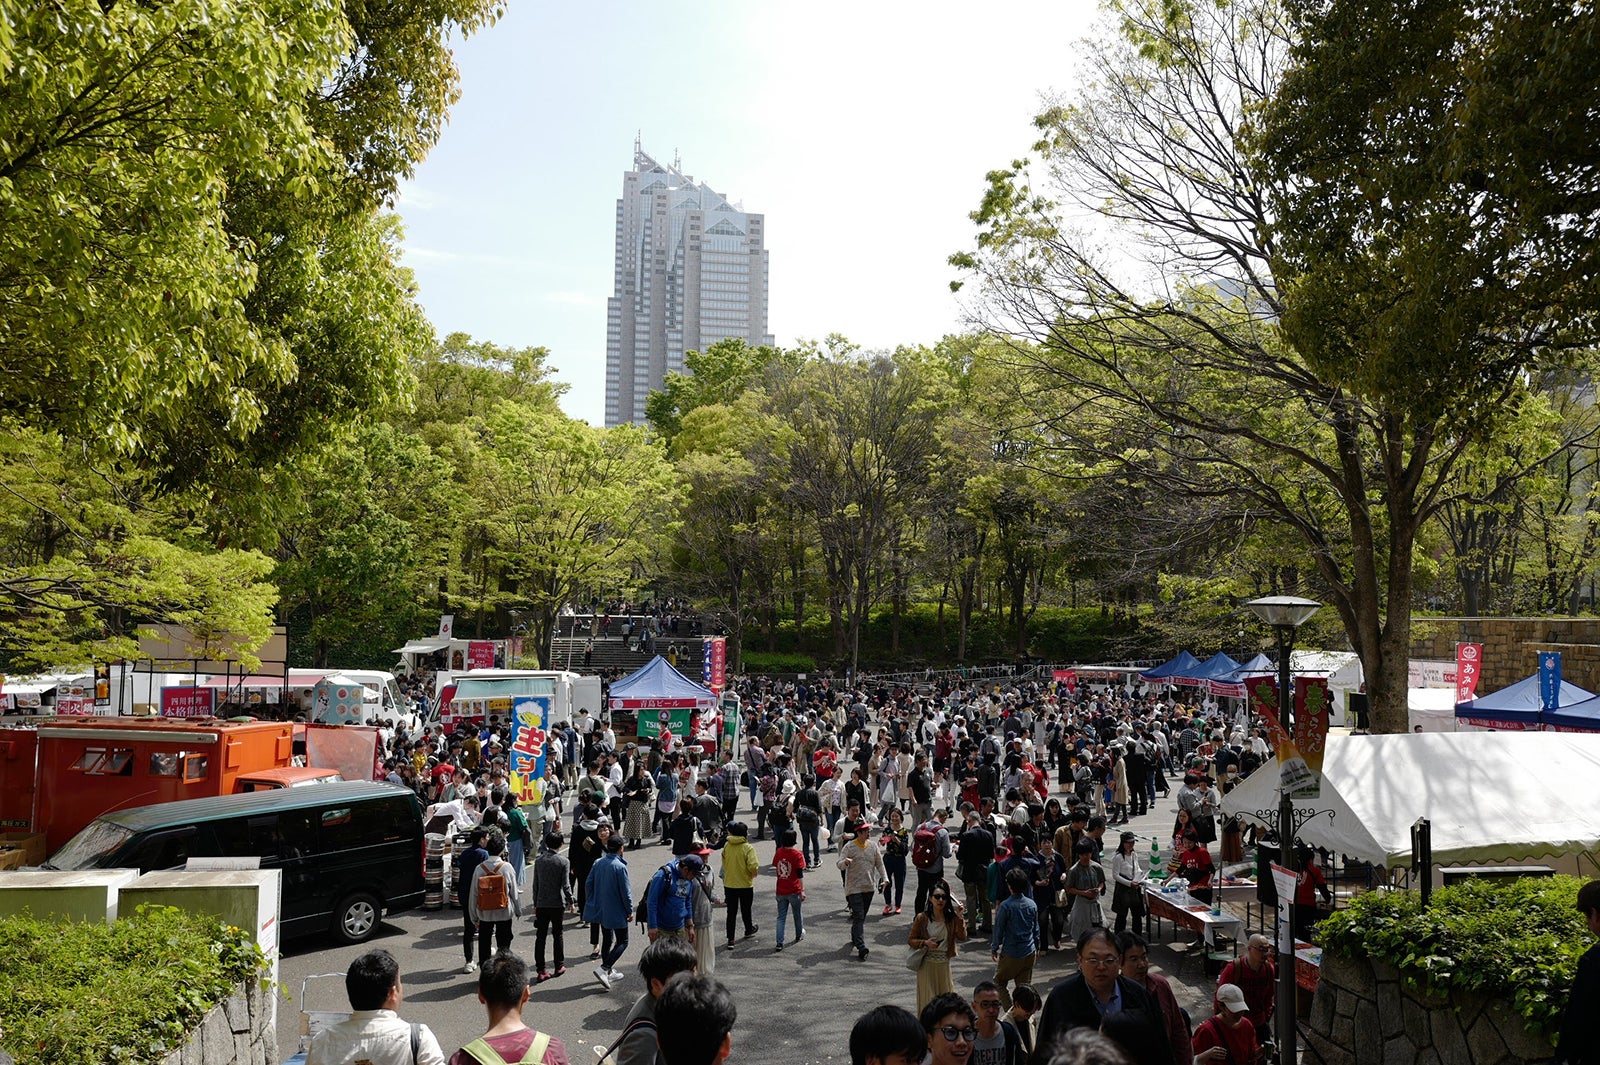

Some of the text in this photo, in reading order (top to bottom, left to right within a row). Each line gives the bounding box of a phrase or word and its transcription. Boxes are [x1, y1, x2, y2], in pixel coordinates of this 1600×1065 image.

[1461, 663, 1474, 697] あみ印
[70, 702, 94, 715] 火鍋
[640, 698, 680, 708] 青島ビール
[1304, 682, 1327, 715] 春
[1307, 716, 1323, 753] らんまん
